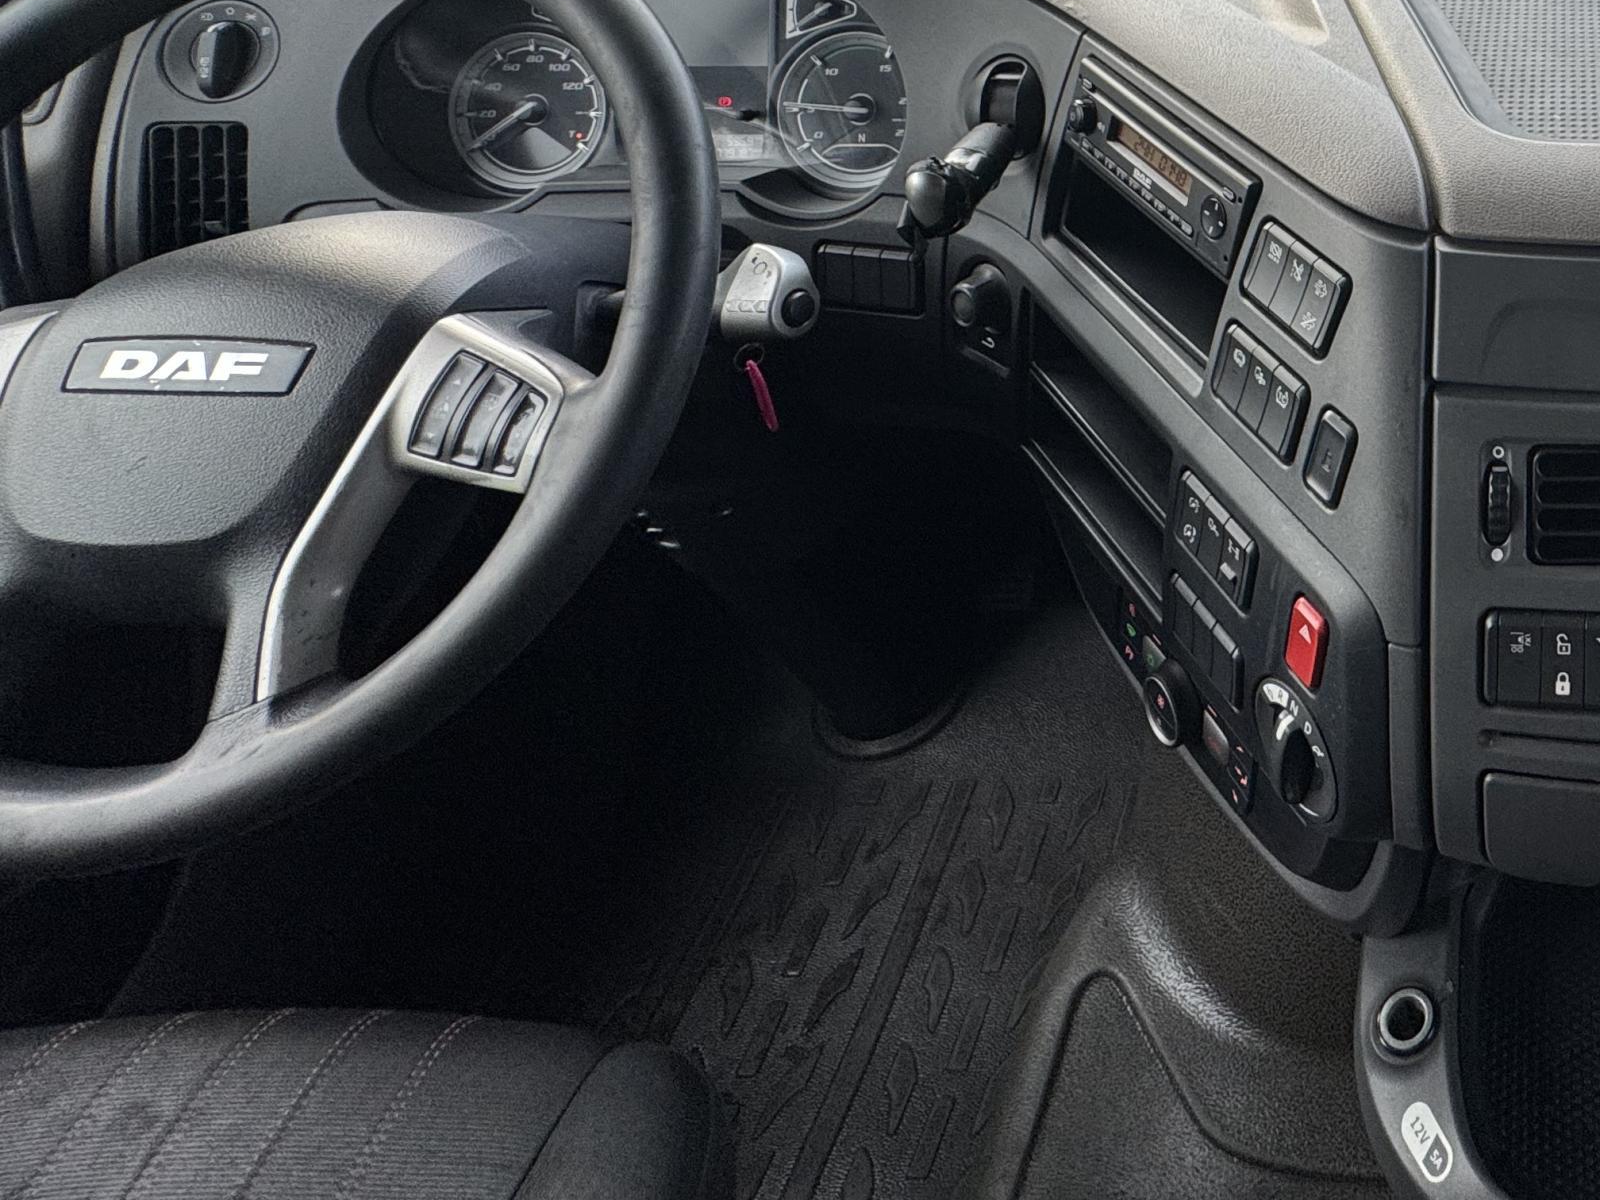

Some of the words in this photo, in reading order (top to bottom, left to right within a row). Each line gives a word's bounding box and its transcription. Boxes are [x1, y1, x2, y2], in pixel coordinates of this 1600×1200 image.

[526, 55, 544, 63] 80
[502, 63, 520, 71] 60
[549, 63, 571, 72] 100
[825, 68, 839, 76] 10
[485, 83, 502, 91] 40
[562, 82, 584, 91] 120
[479, 110, 496, 118] 20
[99, 350, 269, 381] DAF
[1289, 700, 1299, 717] N
[1304, 721, 1312, 735] D
[1410, 1116, 1431, 1145] 12V
[1429, 1149, 1443, 1171] 5A
